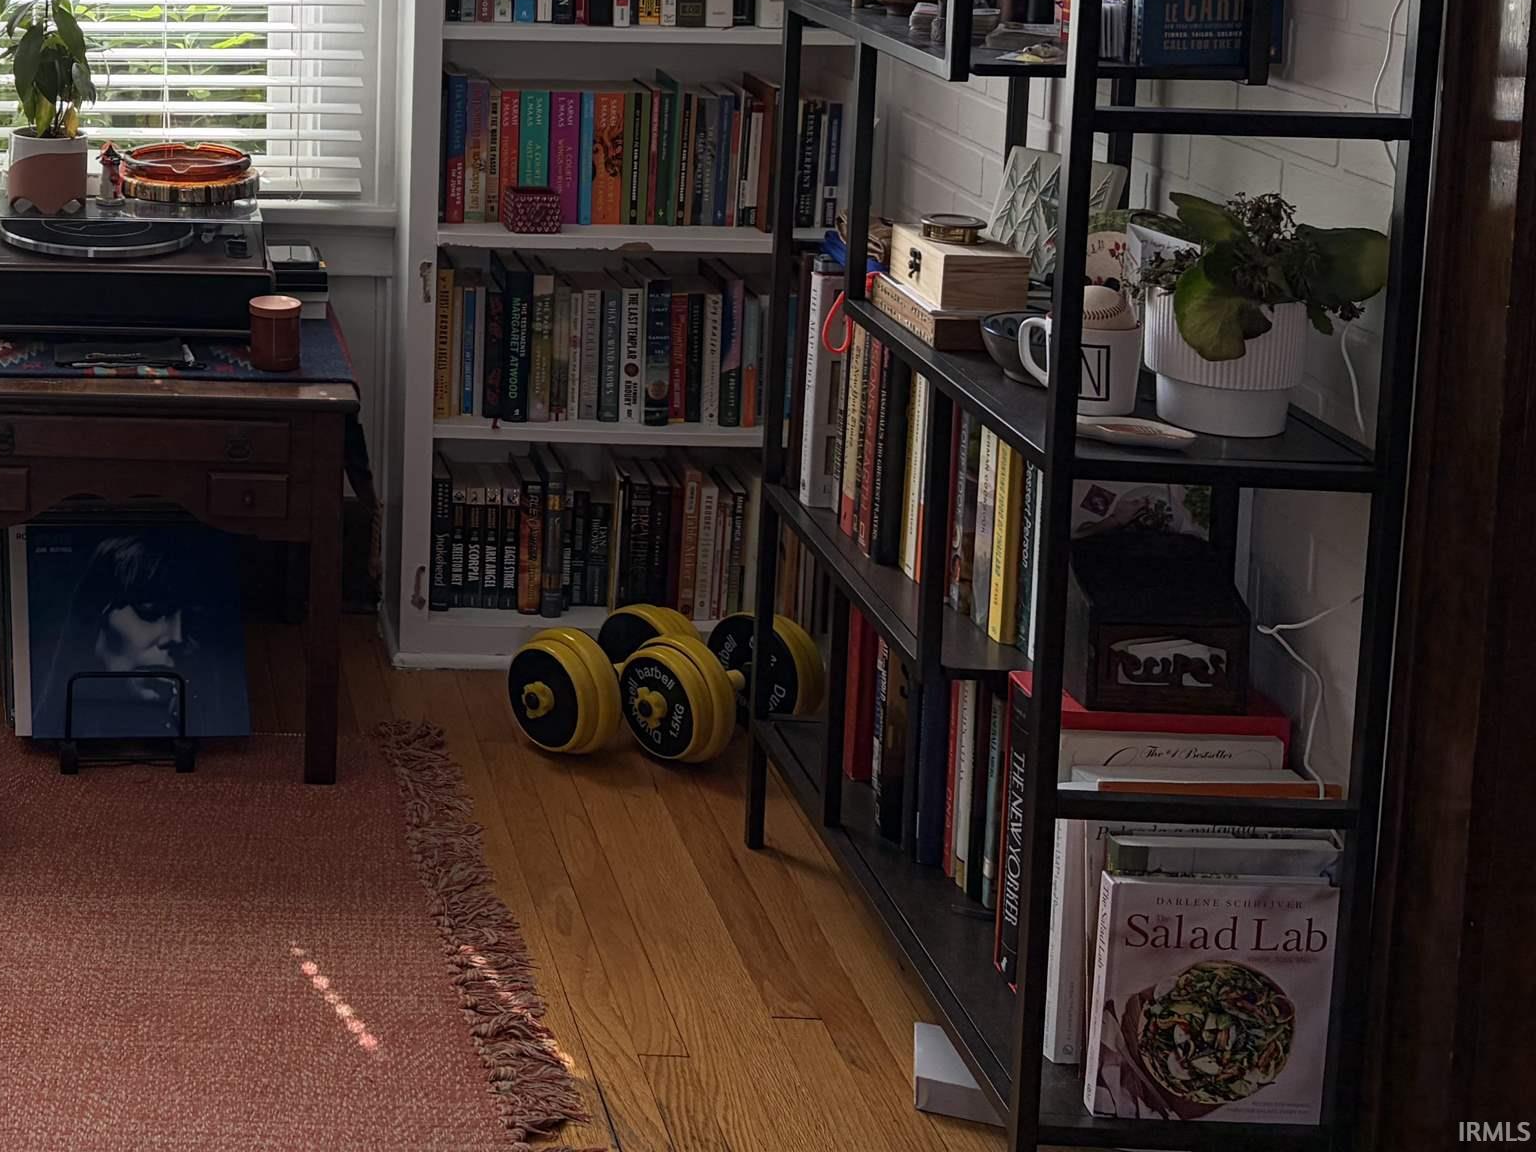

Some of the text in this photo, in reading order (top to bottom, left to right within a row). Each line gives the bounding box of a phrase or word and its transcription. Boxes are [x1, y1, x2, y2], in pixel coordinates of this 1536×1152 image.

[535, 97, 543, 125] SARAH
[566, 99, 574, 126] SARAH
[520, 303, 528, 315] THE
[626, 293, 639, 361] THE LAST TEMPLAR
[508, 297, 521, 400] MARGARET ATWOOD
[860, 438, 875, 510] EARTH
[434, 533, 449, 587] Snakehead
[467, 544, 480, 581] SCORPIA
[1021, 517, 1033, 569] Person
[483, 545, 497, 589] ARK ANGEL
[503, 546, 516, 590] EAGLE STRIKE
[635, 665, 675, 690] barbell
[1144, 745, 1163, 759] The
[1003, 751, 1026, 926] THE NEW YORKER
[1156, 896, 1218, 907] DARLENE
[1125, 913, 1328, 953] Salad Lab
